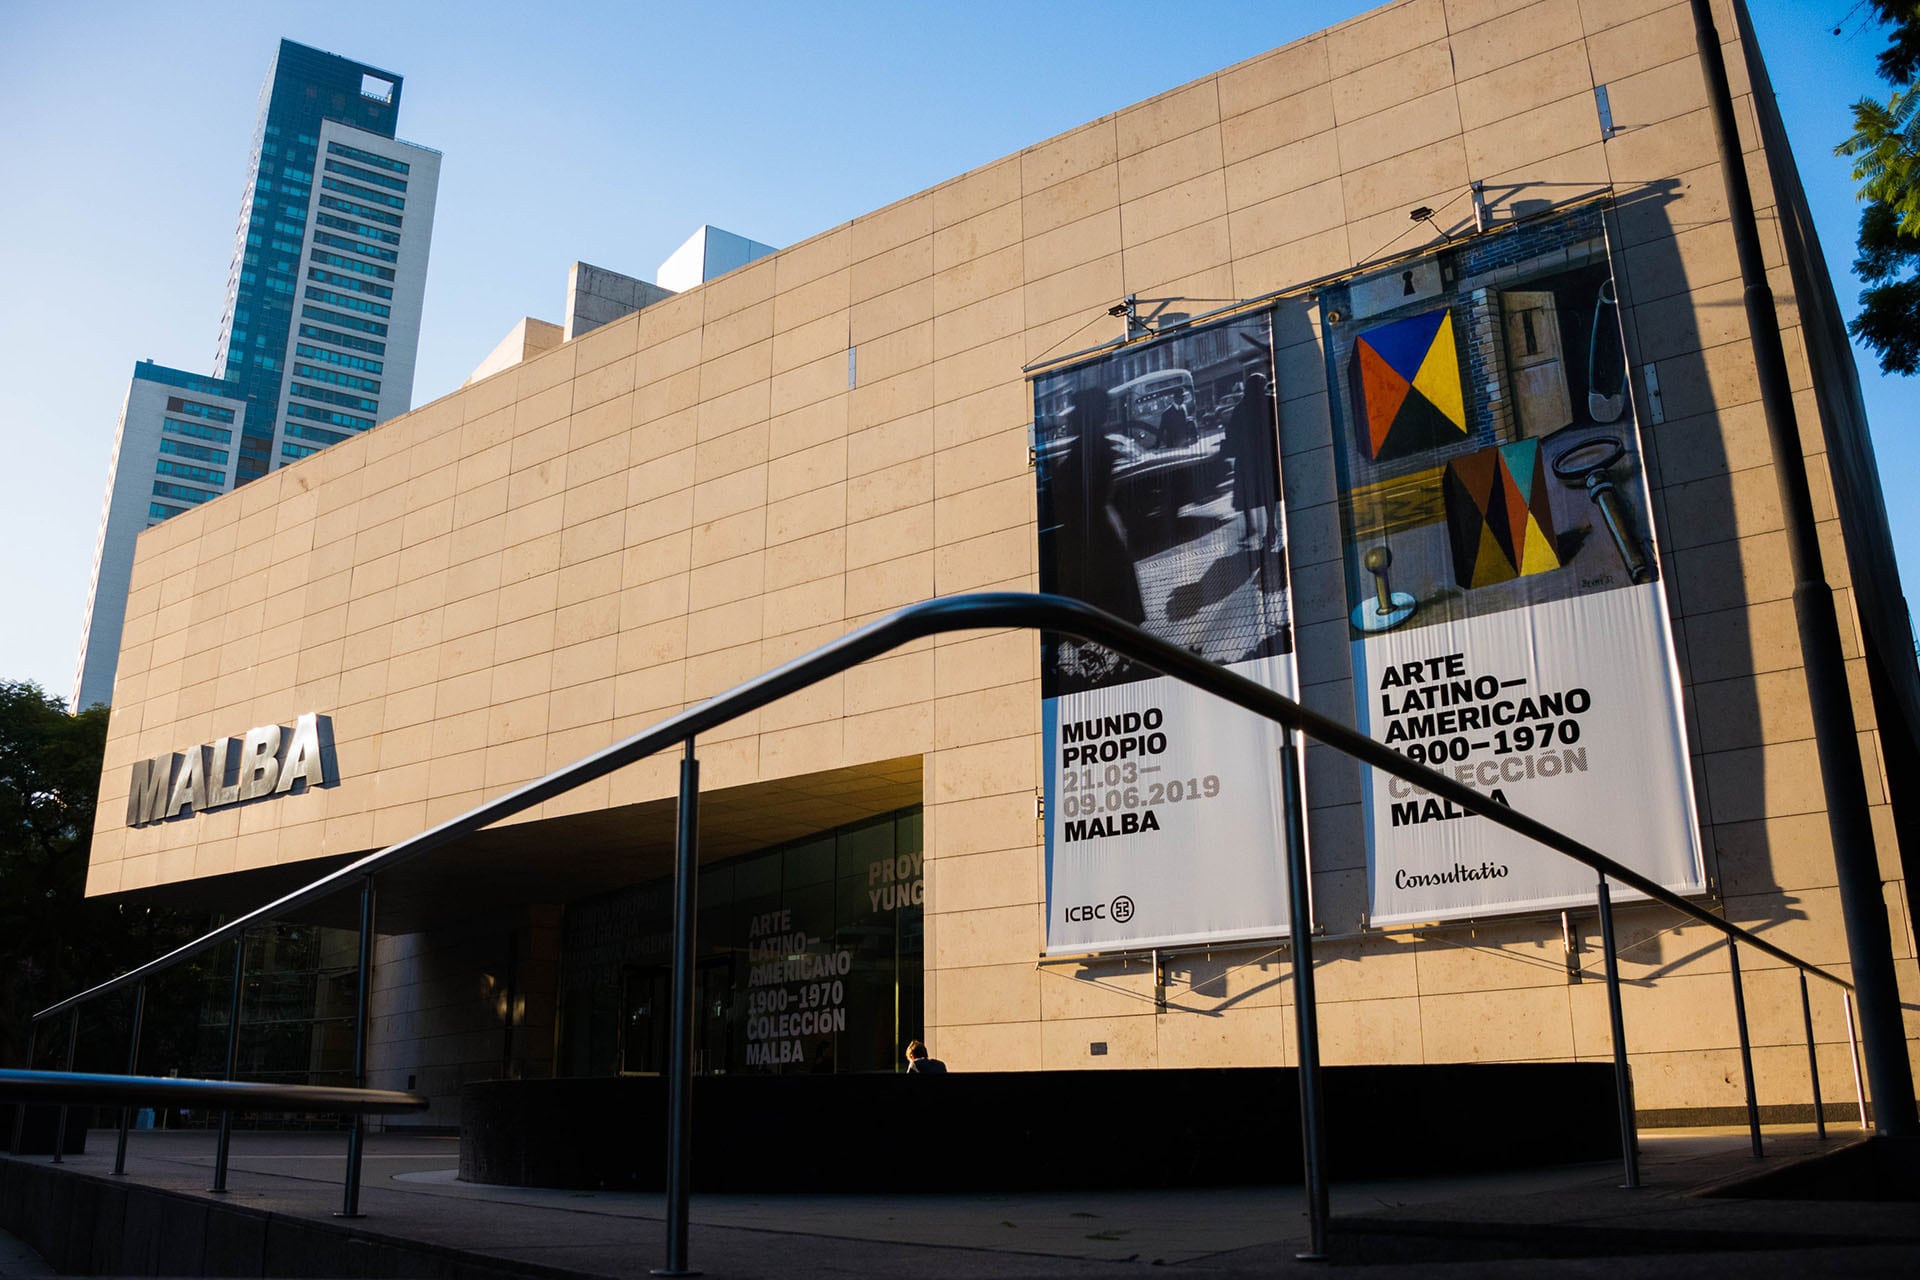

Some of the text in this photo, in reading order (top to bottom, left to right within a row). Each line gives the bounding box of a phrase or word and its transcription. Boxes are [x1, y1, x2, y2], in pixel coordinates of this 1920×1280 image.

[1380, 652, 1466, 690] ARTE
[1062, 707, 1163, 744] MUNDO
[1384, 688, 1591, 744] AMERICANO
[1063, 732, 1167, 768] PROPIO
[1391, 718, 1580, 766] 900–1970
[126, 711, 324, 827] MALBA
[1388, 747, 1588, 799] CECCIÓN
[1063, 774, 1220, 818] 09.06.2019
[1391, 788, 1511, 827] MALA
[1064, 810, 1160, 843] MALBA
[868, 852, 924, 887] PROY
[1395, 862, 1509, 890] Consultatio
[868, 880, 924, 913] YUNG
[1065, 904, 1106, 923] ICBC
[750, 910, 792, 939] ARTE
[748, 950, 851, 988] AMERICANO
[746, 1008, 846, 1041] COLECCIÓN
[745, 1040, 804, 1066] MALBA
